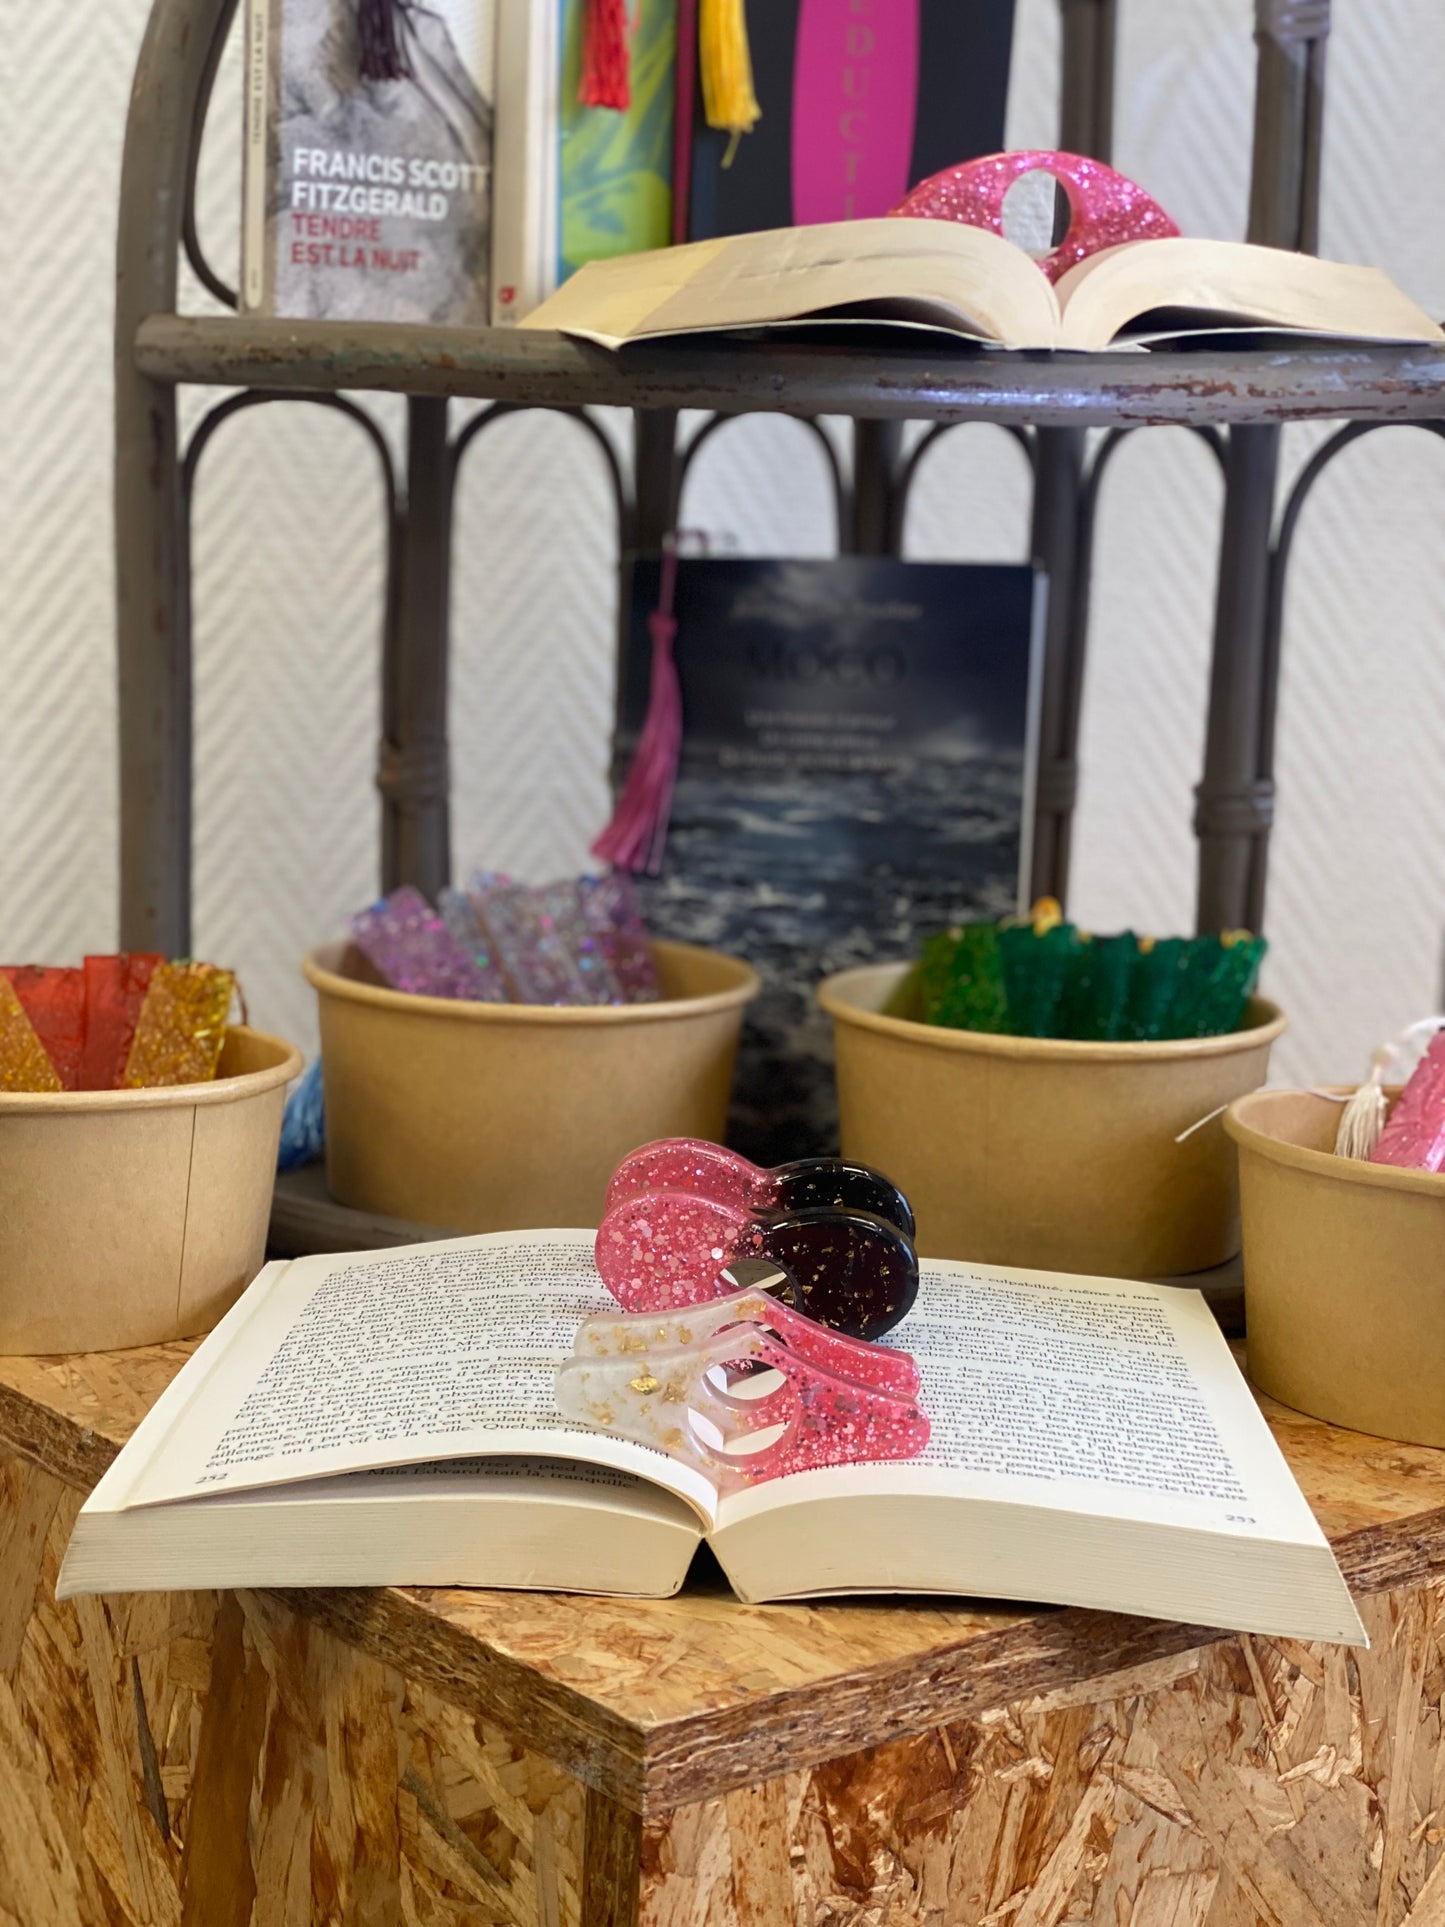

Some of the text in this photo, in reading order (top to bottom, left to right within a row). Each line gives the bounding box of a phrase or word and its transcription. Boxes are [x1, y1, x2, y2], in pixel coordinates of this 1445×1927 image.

[292, 147, 489, 194] FRANCIS SCOTT
[291, 180, 449, 221] FITZGERALD
[291, 213, 381, 243] TENDRE
[291, 242, 422, 274] EST LA NUIT
[194, 1473, 228, 1484] 252
[413, 1467, 480, 1475] Edward
[485, 1468, 519, 1476] était
[452, 1460, 509, 1468] rentrer
[539, 1463, 577, 1472] pied
[586, 1468, 640, 1482] quand
[1225, 1513, 1257, 1525] 253
